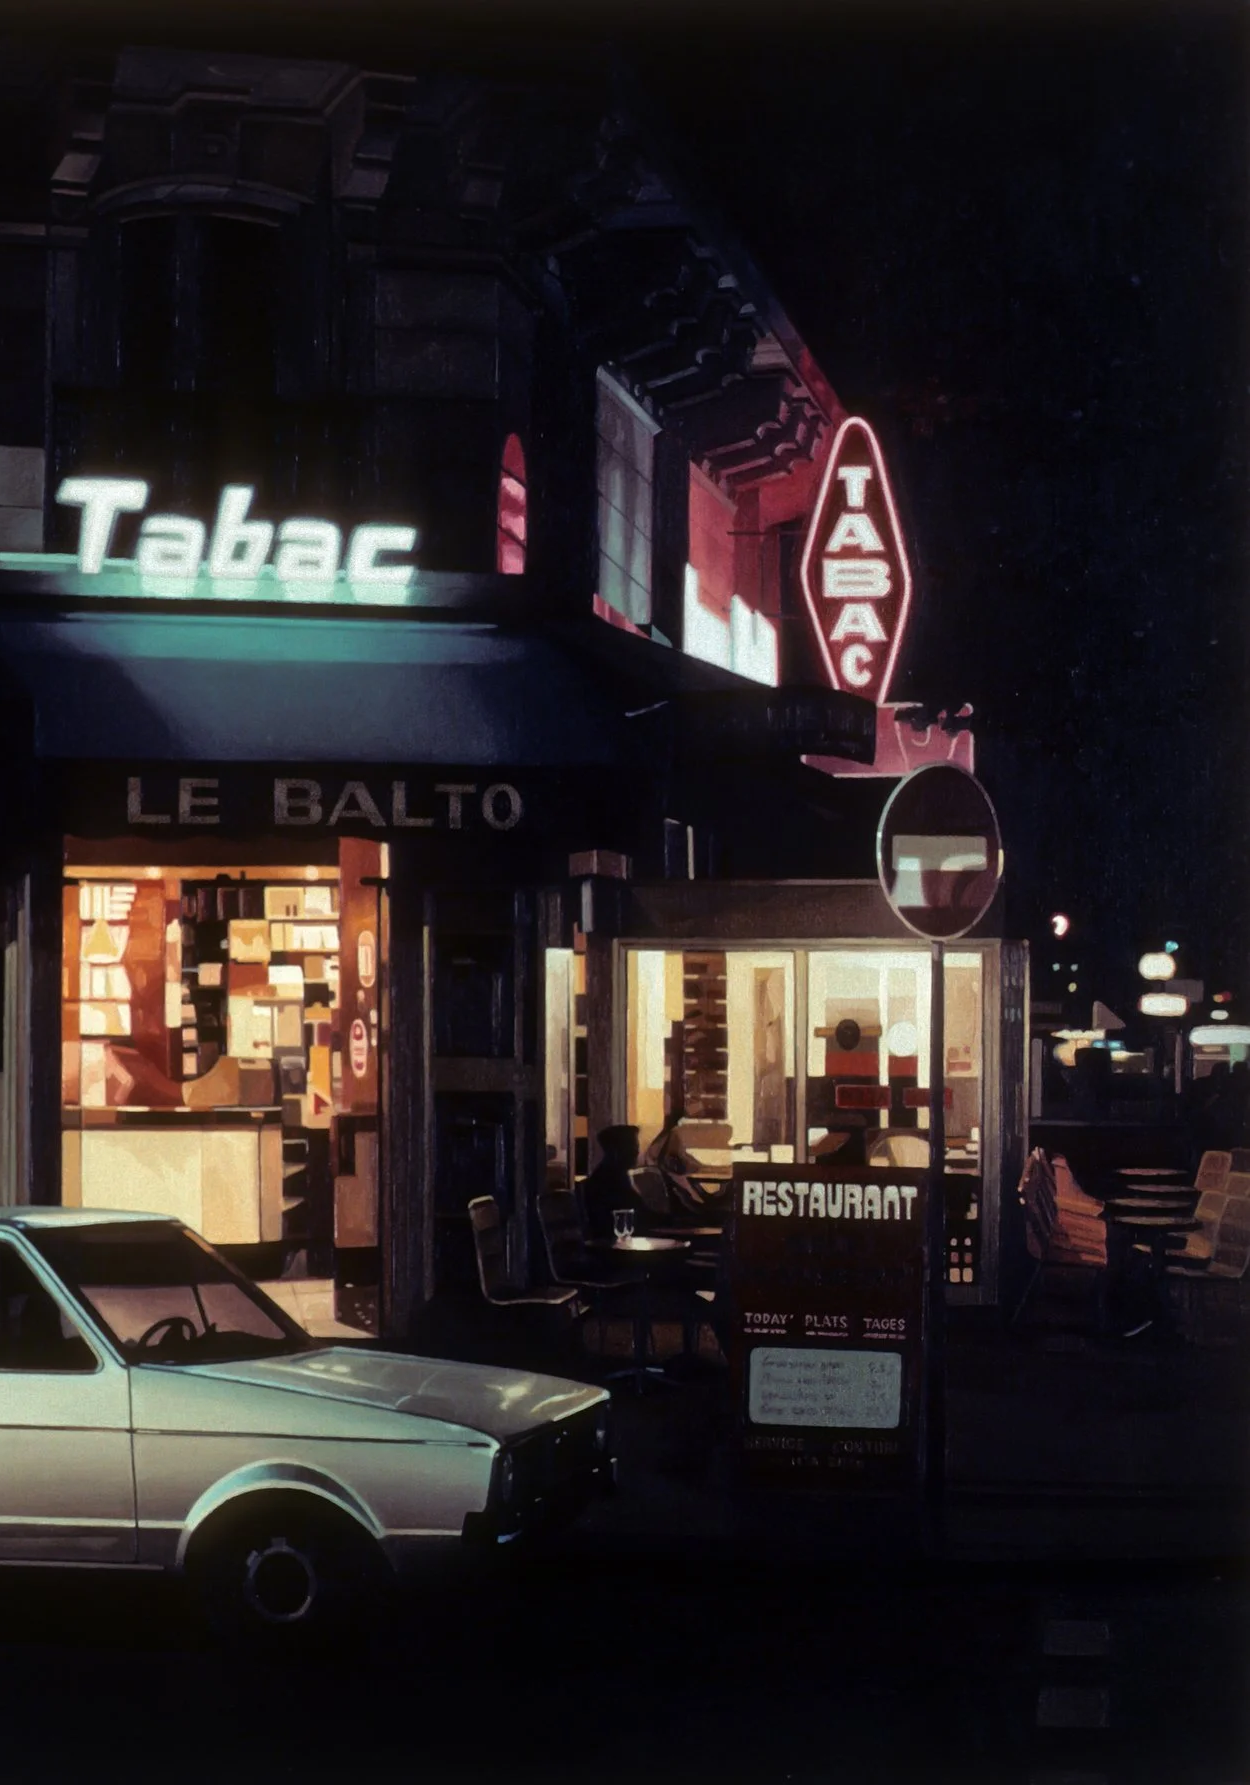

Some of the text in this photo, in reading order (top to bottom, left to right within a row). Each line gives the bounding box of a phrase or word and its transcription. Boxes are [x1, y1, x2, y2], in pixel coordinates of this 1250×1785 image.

[56, 476, 418, 586] Tabac
[821, 464, 892, 687] TABAC
[126, 776, 523, 831] LE BALTO
[742, 1180, 918, 1221] RESTAURANT
[805, 1314, 849, 1329] PLATS
[862, 1317, 907, 1332] TAGES
